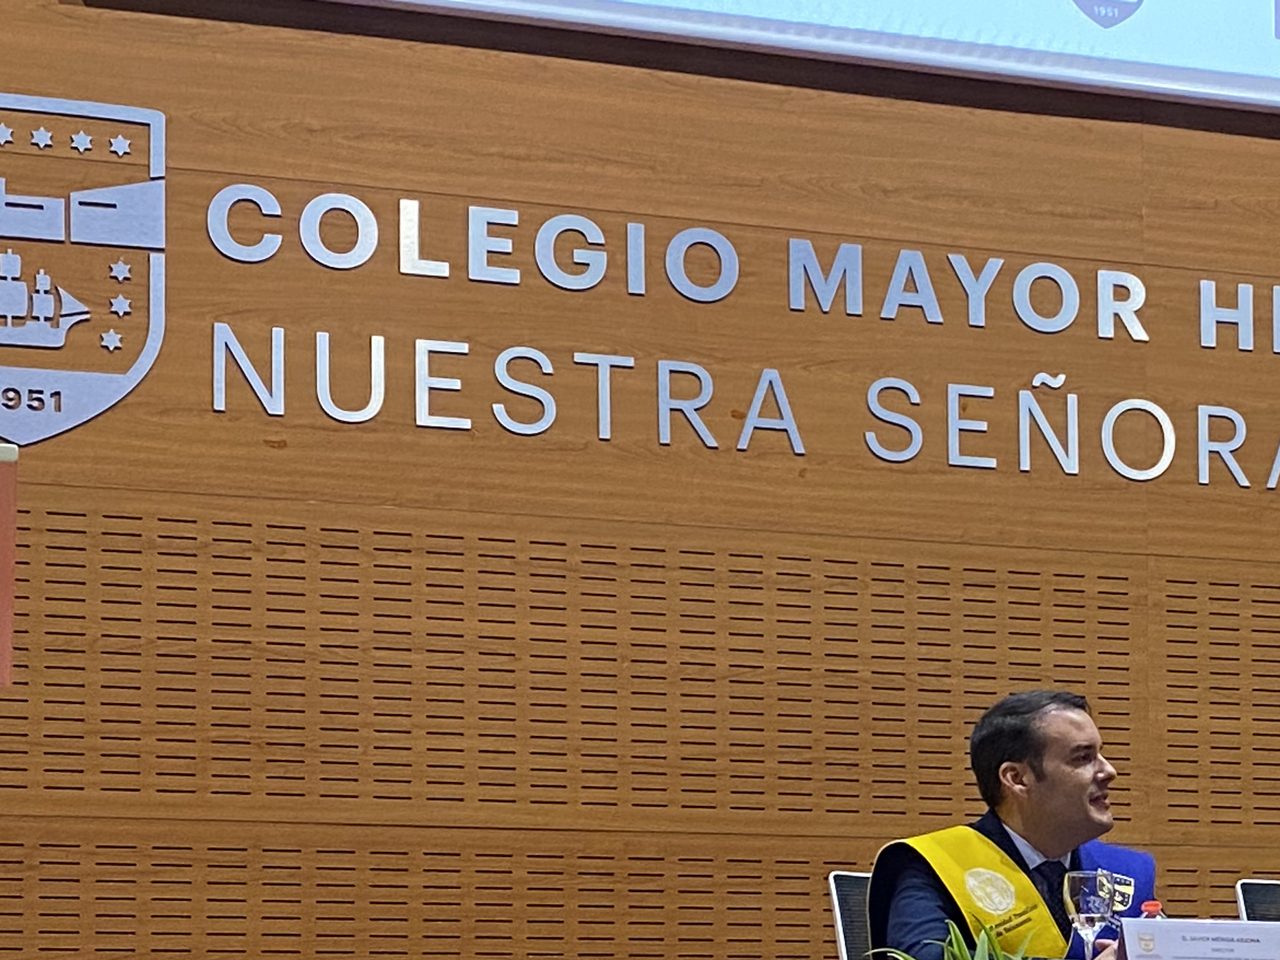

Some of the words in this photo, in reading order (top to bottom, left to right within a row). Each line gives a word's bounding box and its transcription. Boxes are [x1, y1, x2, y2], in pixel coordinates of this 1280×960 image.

[208, 184, 739, 303] COLEGIO
[789, 239, 1146, 340] MAYOR
[214, 323, 804, 455] NUESTRA
